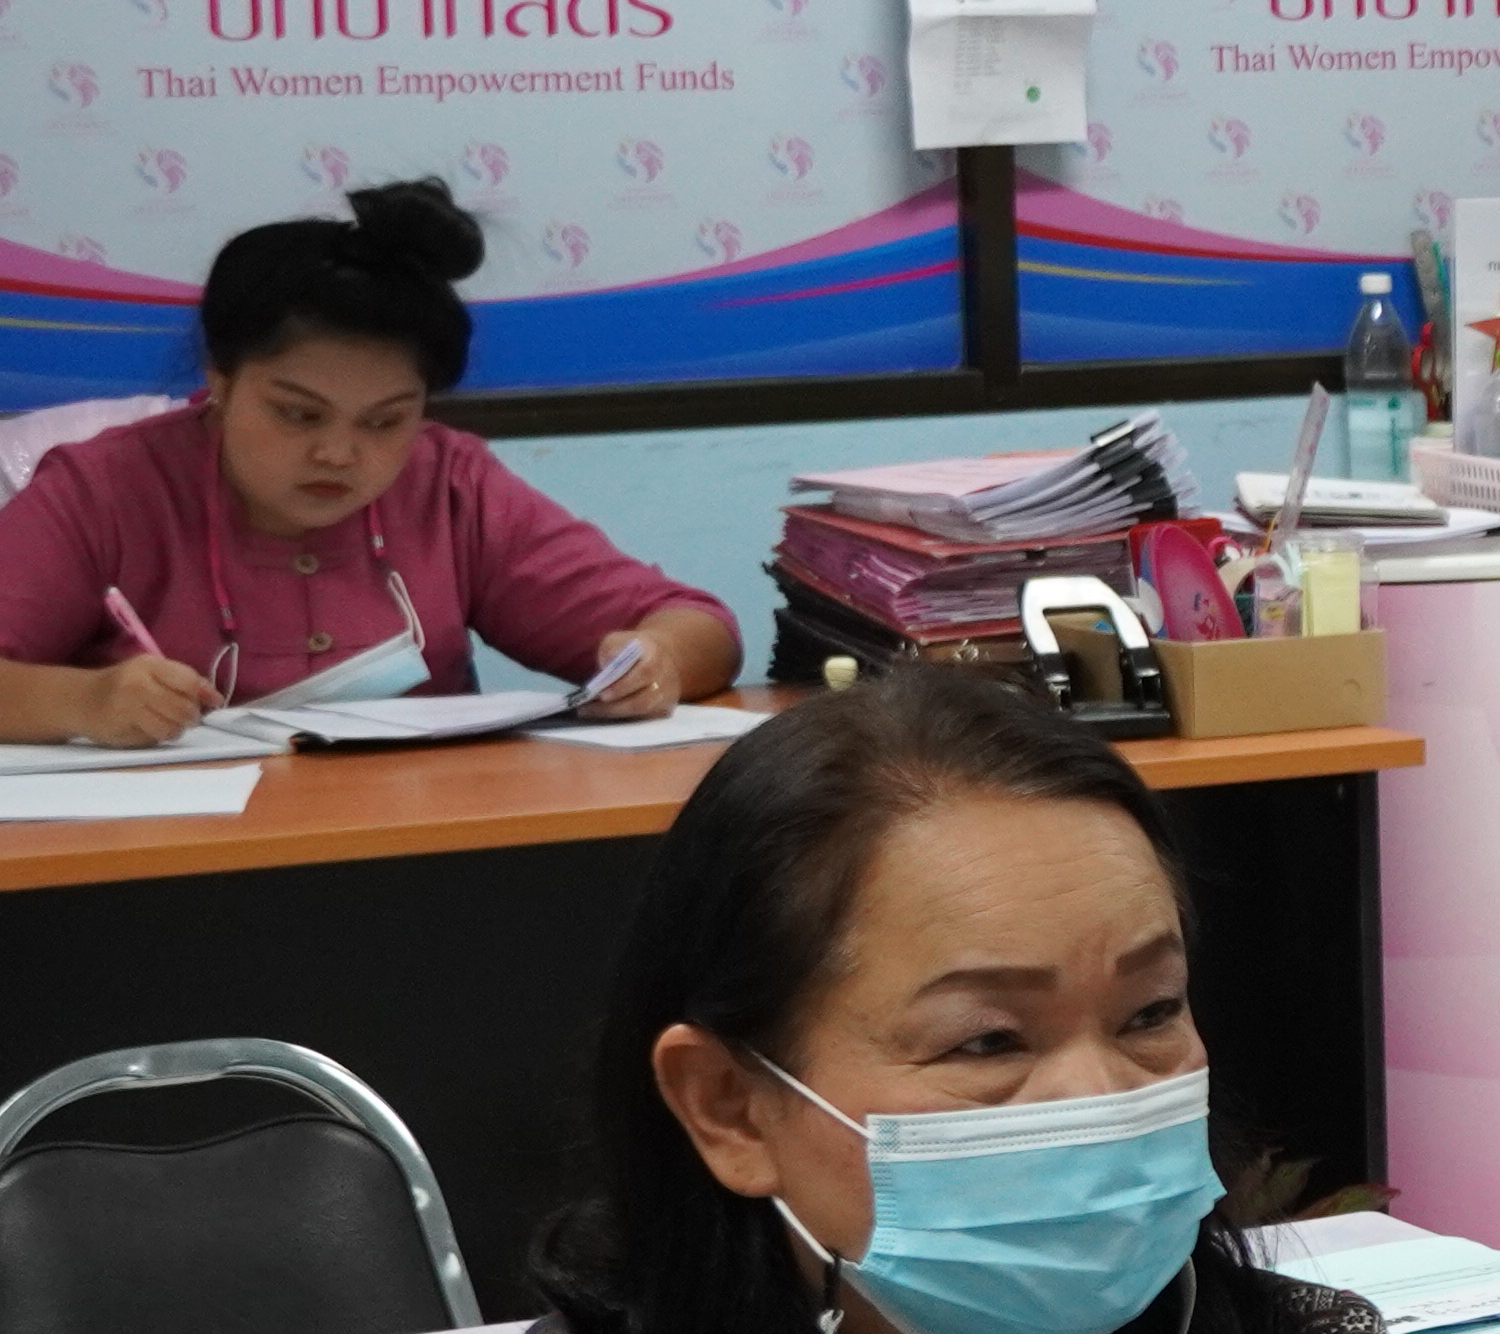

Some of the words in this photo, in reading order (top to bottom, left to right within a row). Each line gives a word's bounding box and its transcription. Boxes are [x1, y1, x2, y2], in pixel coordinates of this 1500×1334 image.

[1211, 42, 1277, 74] Thai
[1286, 42, 1398, 72] Women
[138, 67, 218, 100] Thai
[233, 66, 365, 99] Women
[376, 64, 624, 104] Empowerment
[635, 61, 738, 95] Funds
